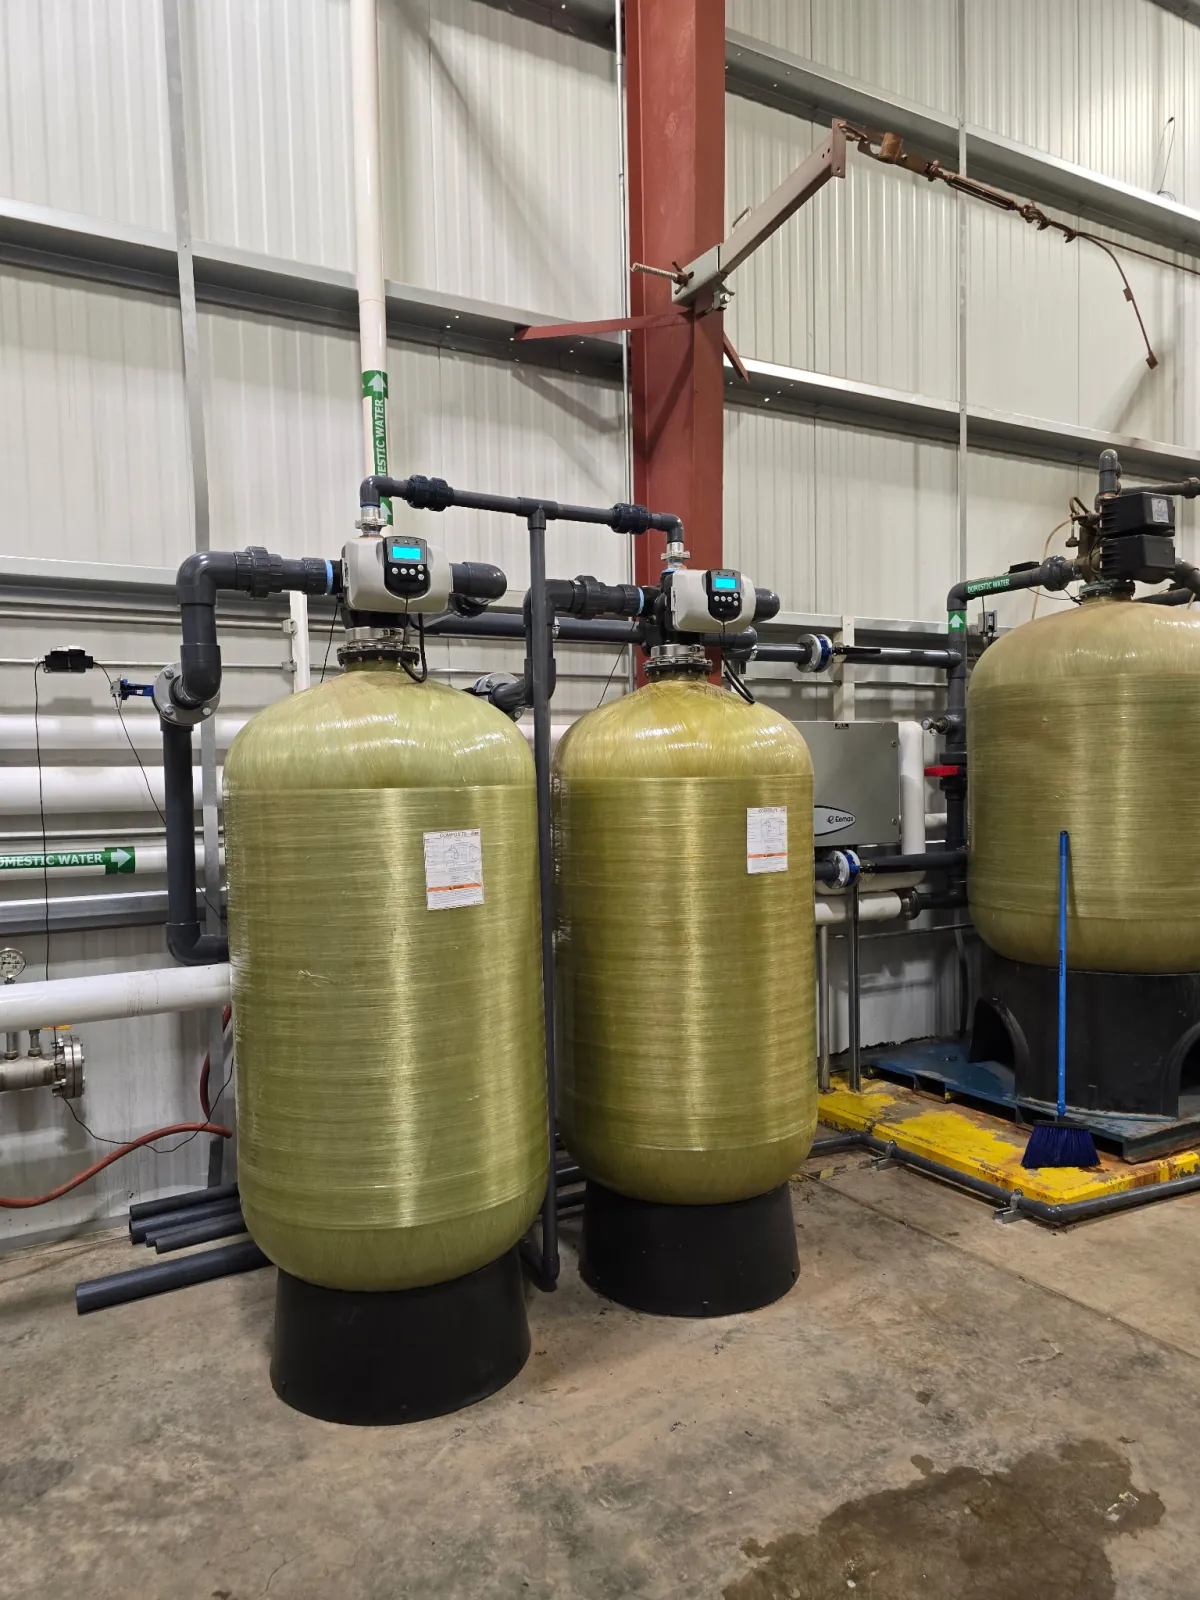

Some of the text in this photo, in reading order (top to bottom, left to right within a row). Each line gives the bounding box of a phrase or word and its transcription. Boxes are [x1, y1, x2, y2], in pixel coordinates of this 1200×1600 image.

[375, 399, 387, 477] ESTIC WATER
[967, 578, 1010, 594] DOMESTIC WATER
[58, 853, 104, 865] WATER
